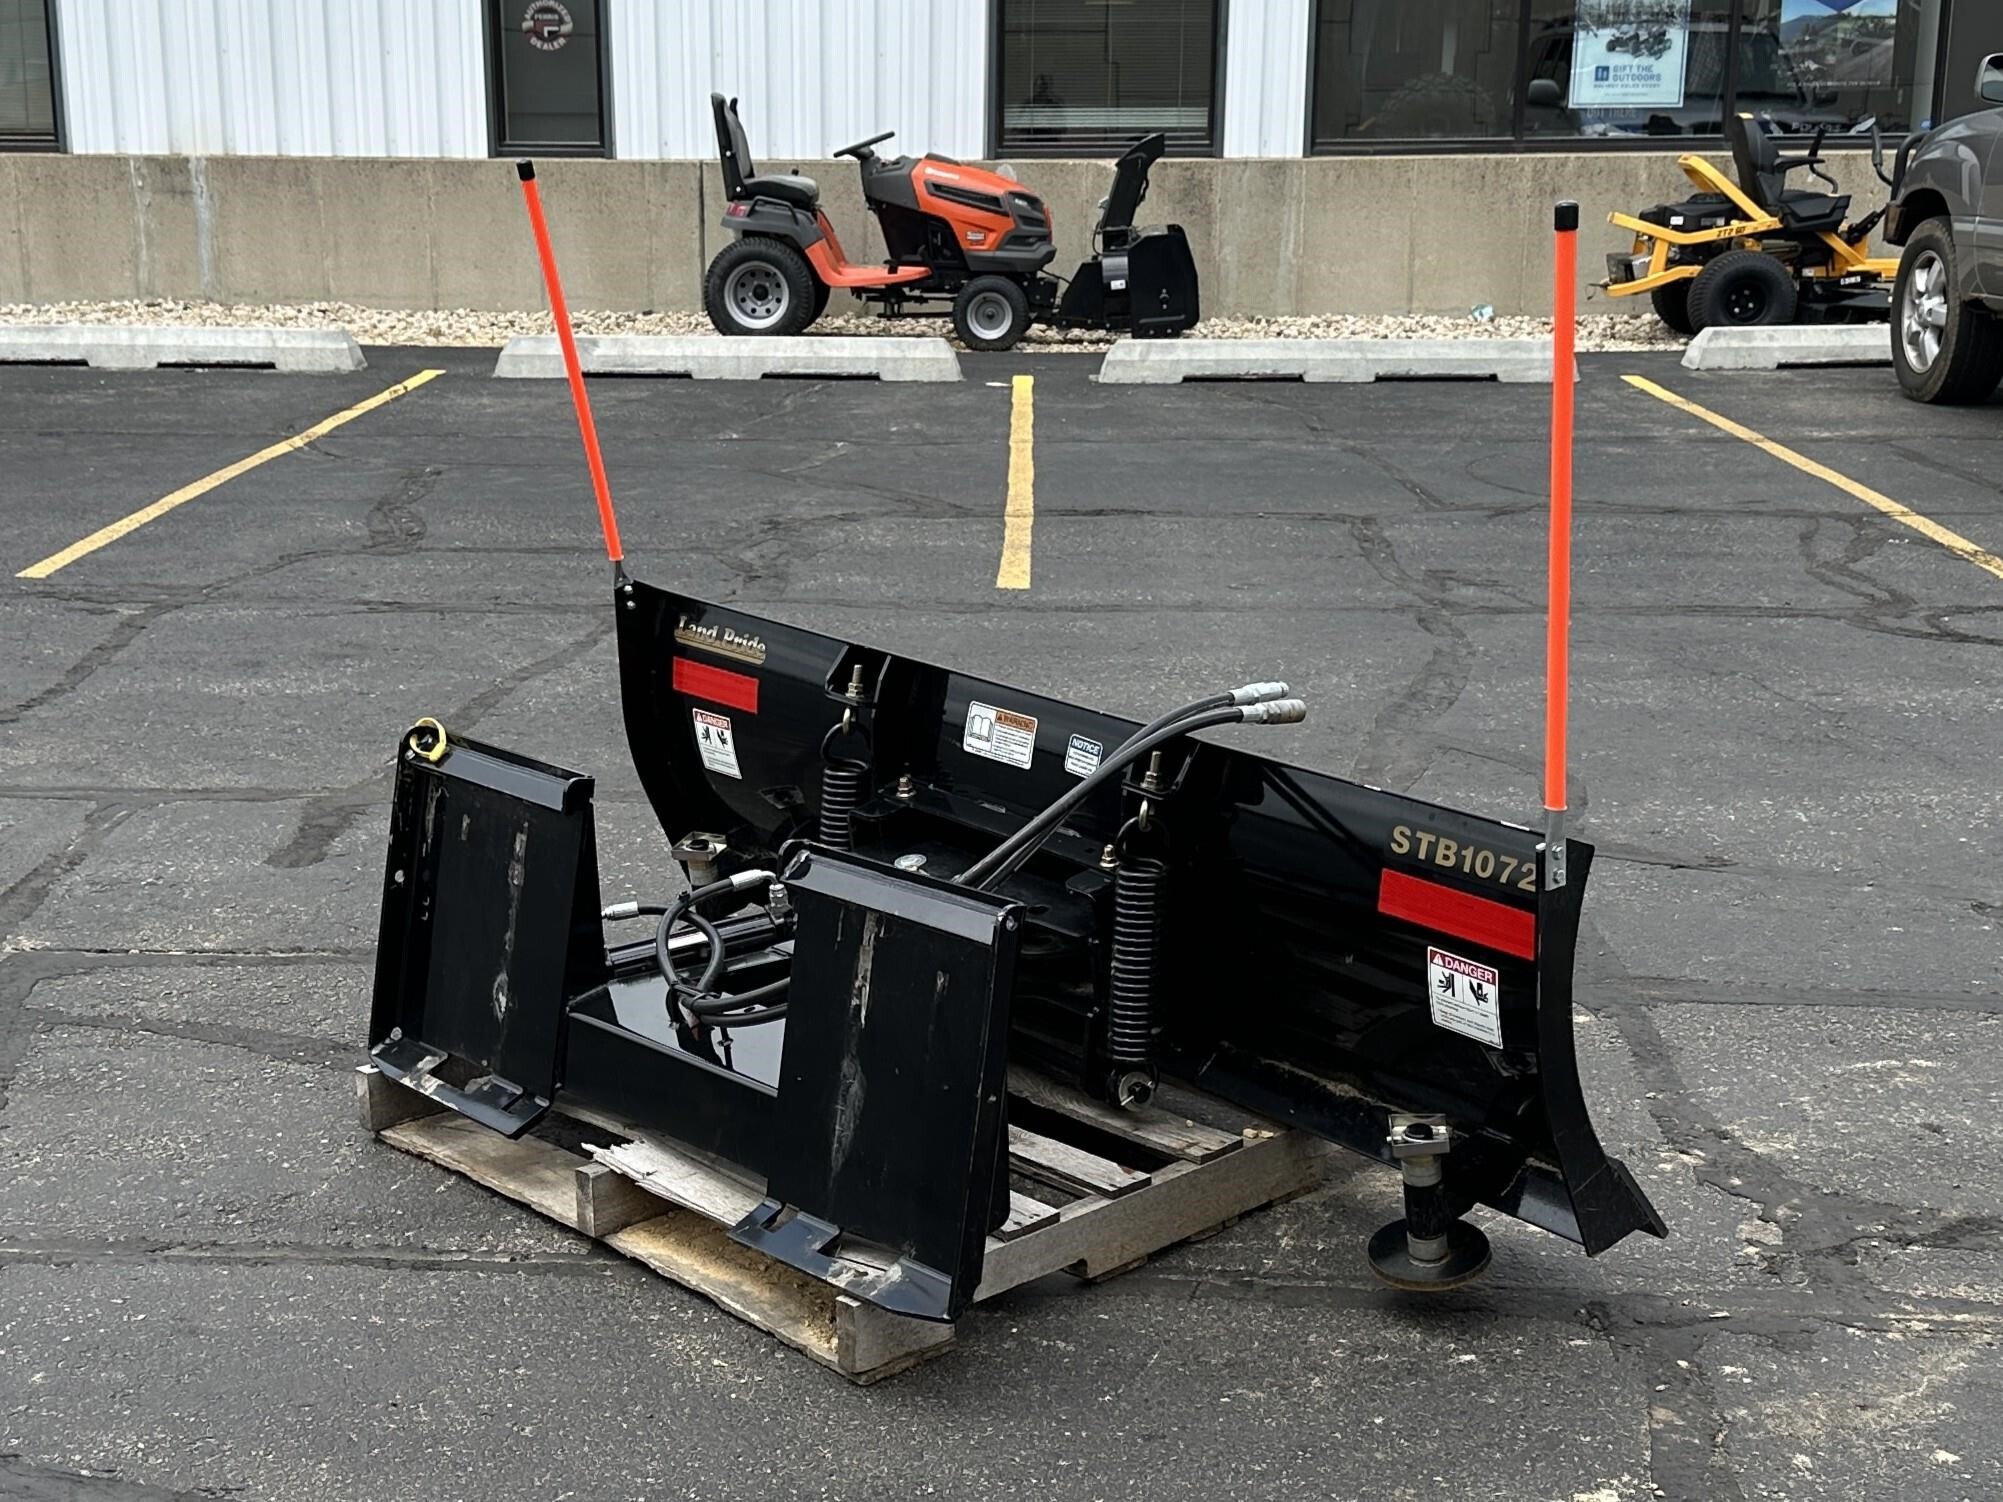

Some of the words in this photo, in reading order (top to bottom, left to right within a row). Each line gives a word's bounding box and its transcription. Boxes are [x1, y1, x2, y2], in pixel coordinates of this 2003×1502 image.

[524, 0, 571, 22] AUTHORIZED
[529, 37, 568, 51] DEALER
[1612, 64, 1633, 73] GIFT
[1636, 64, 1653, 73] THE
[1612, 73, 1662, 82] OUTDOORS
[678, 615, 718, 642] Land
[722, 627, 767, 652] Pride
[702, 713, 728, 728] DANGER
[1003, 714, 1034, 730] WARNING
[1071, 737, 1100, 755] NOTICE
[1390, 825, 1537, 893] STB1072
[1445, 957, 1493, 983] DANGER
